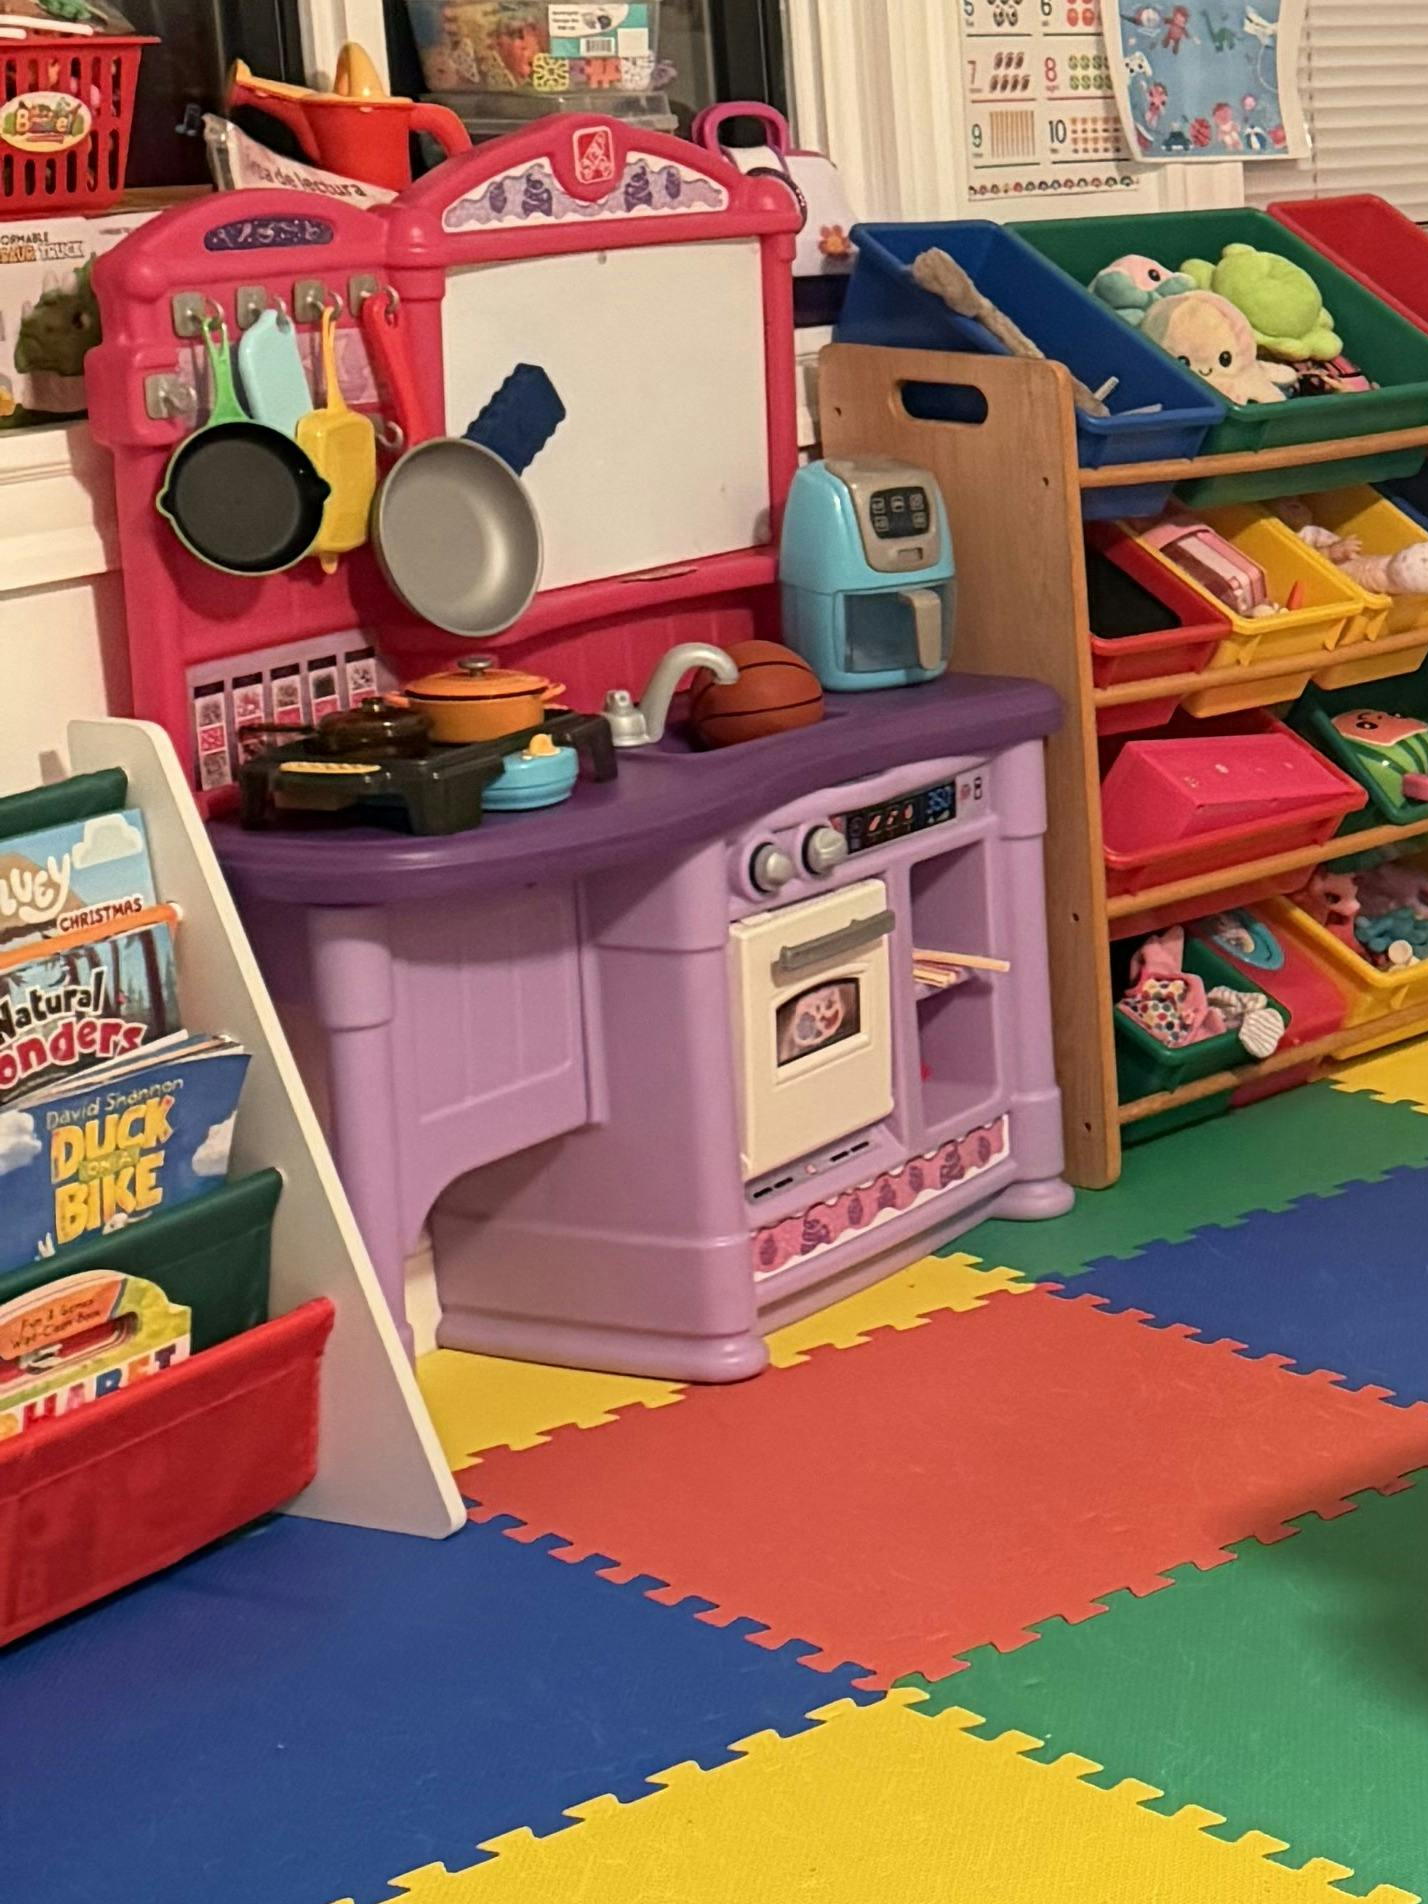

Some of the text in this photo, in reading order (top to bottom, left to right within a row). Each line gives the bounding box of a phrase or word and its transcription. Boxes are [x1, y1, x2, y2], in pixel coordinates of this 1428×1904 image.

[967, 57, 1058, 85] 7 8
[971, 119, 1067, 148] 9 10
[59, 897, 143, 933] CHRISTMAS
[46, 1078, 184, 1130] David Shannon
[51, 1094, 176, 1184] DUCK
[54, 1150, 166, 1245] BIKE
